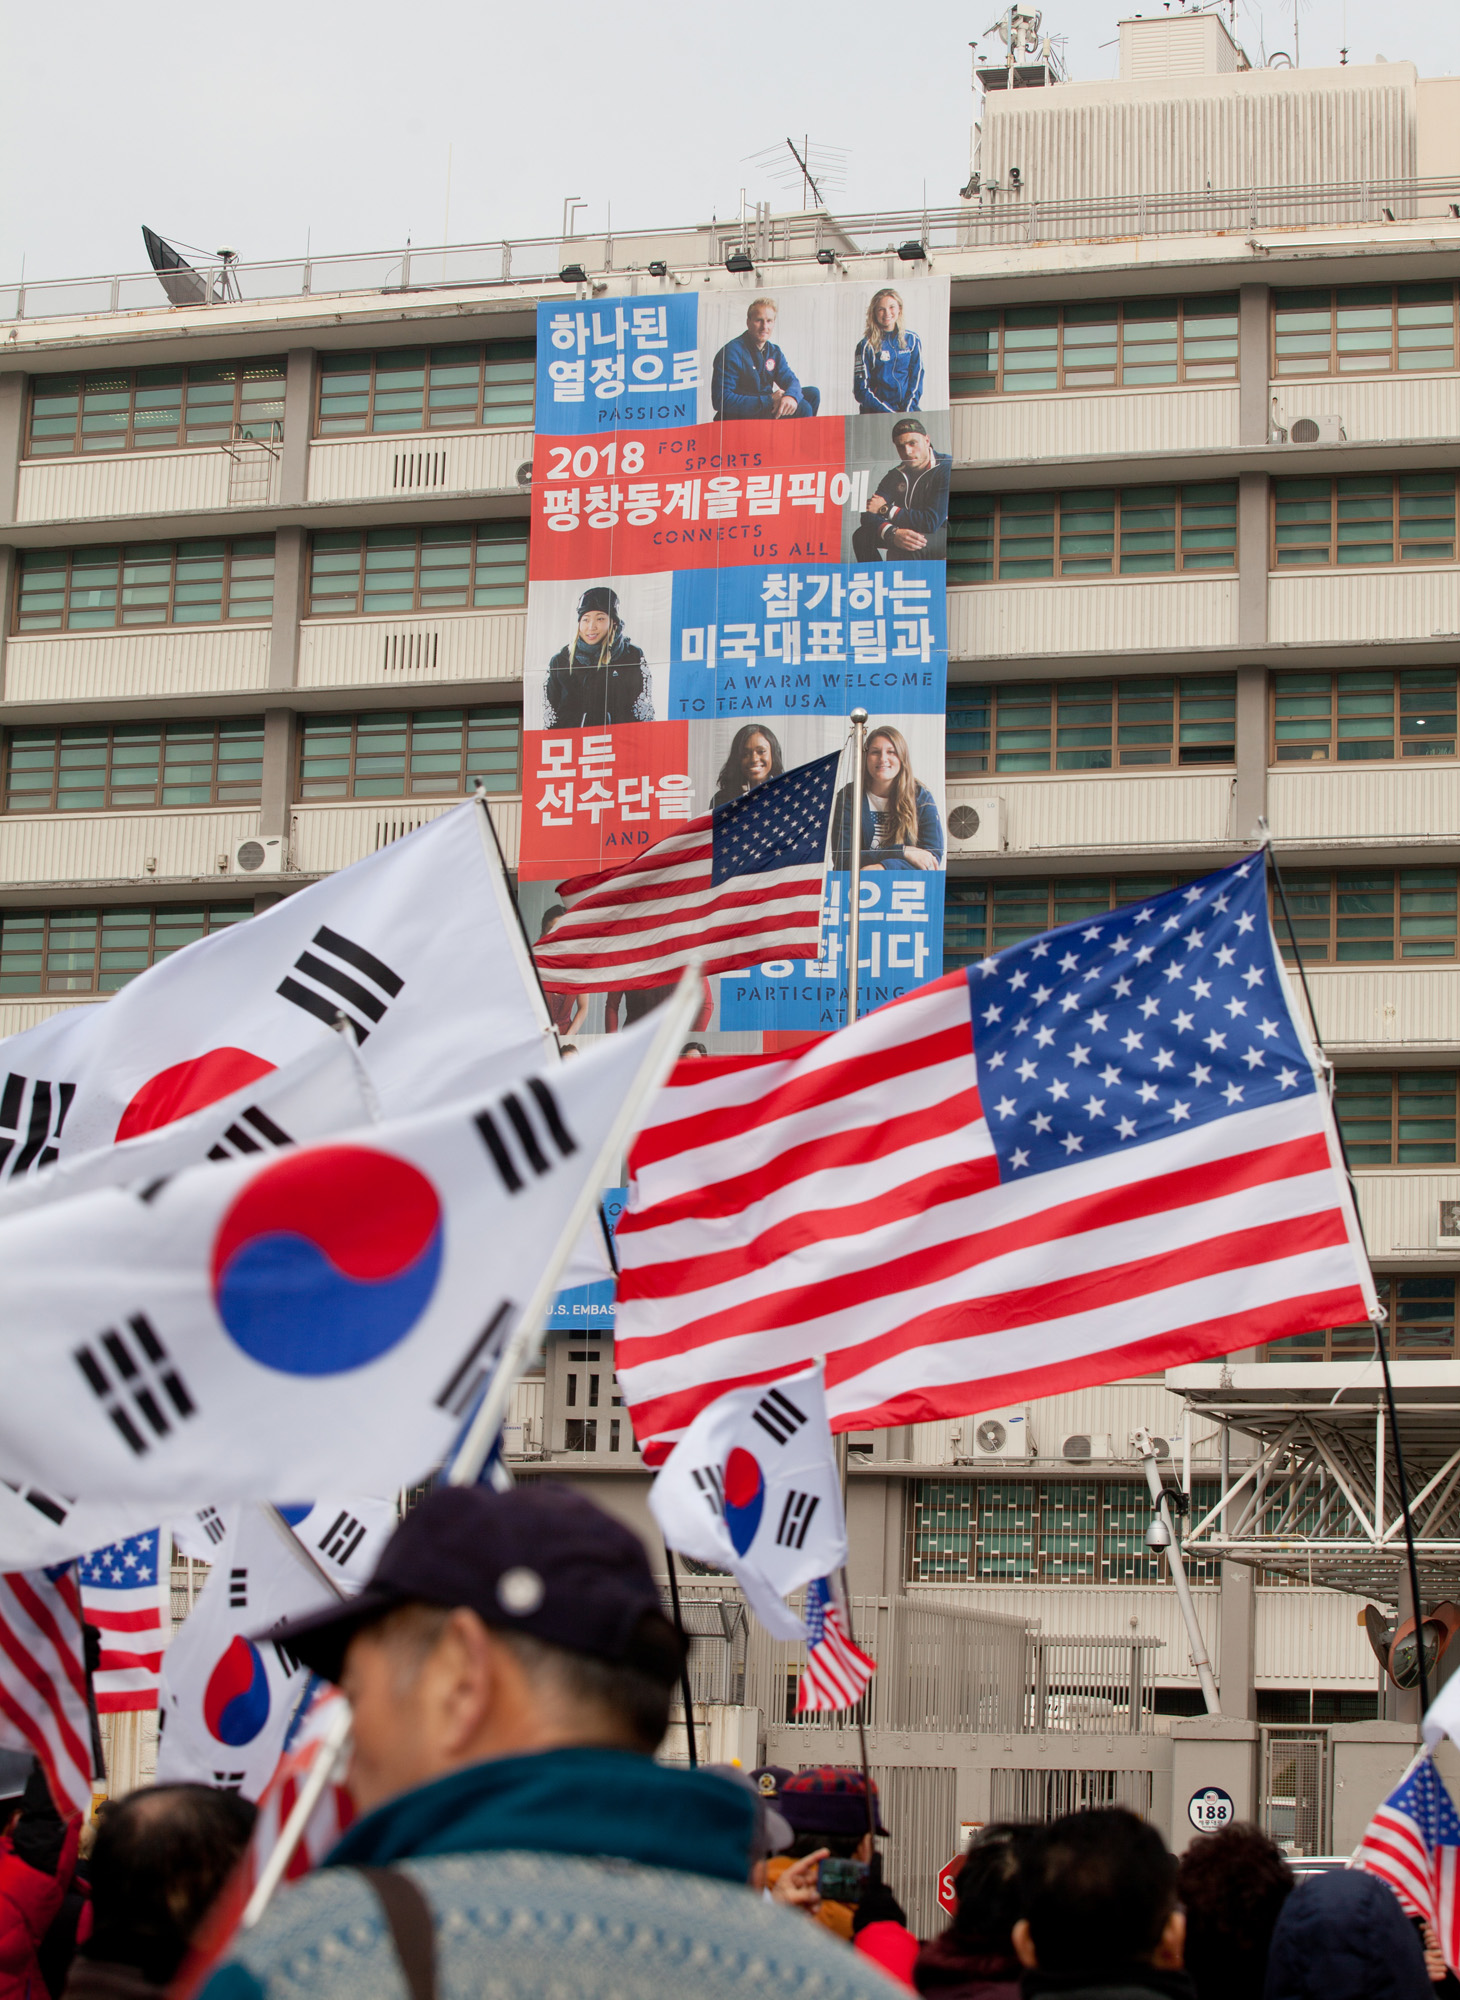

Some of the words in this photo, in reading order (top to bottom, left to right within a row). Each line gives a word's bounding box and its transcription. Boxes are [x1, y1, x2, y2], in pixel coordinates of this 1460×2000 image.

[549, 305, 668, 355] 하나된
[548, 349, 704, 402] 열정으로
[598, 404, 686, 422] PASSION
[658, 439, 696, 454] FOR
[546, 441, 645, 479] 2018
[686, 453, 762, 471] SPORTS
[543, 470, 870, 531] 평창동계올림픽에
[653, 524, 762, 544] CONNECTS
[753, 544, 778, 557] US
[789, 541, 829, 556] ALL
[760, 570, 931, 617] 참가하는
[681, 618, 935, 668] 미국대표팀과
[724, 676, 736, 690] A
[744, 674, 811, 689] WARM
[822, 672, 933, 688] WELCOME
[679, 698, 706, 712] TO
[716, 695, 772, 711] TEAM
[784, 694, 827, 708] USA
[536, 734, 616, 779] 모든
[536, 774, 696, 826] 선수단을
[605, 831, 650, 846] AND
[545, 1304, 570, 1315] U.S.
[1196, 1805, 1227, 1819] 188
